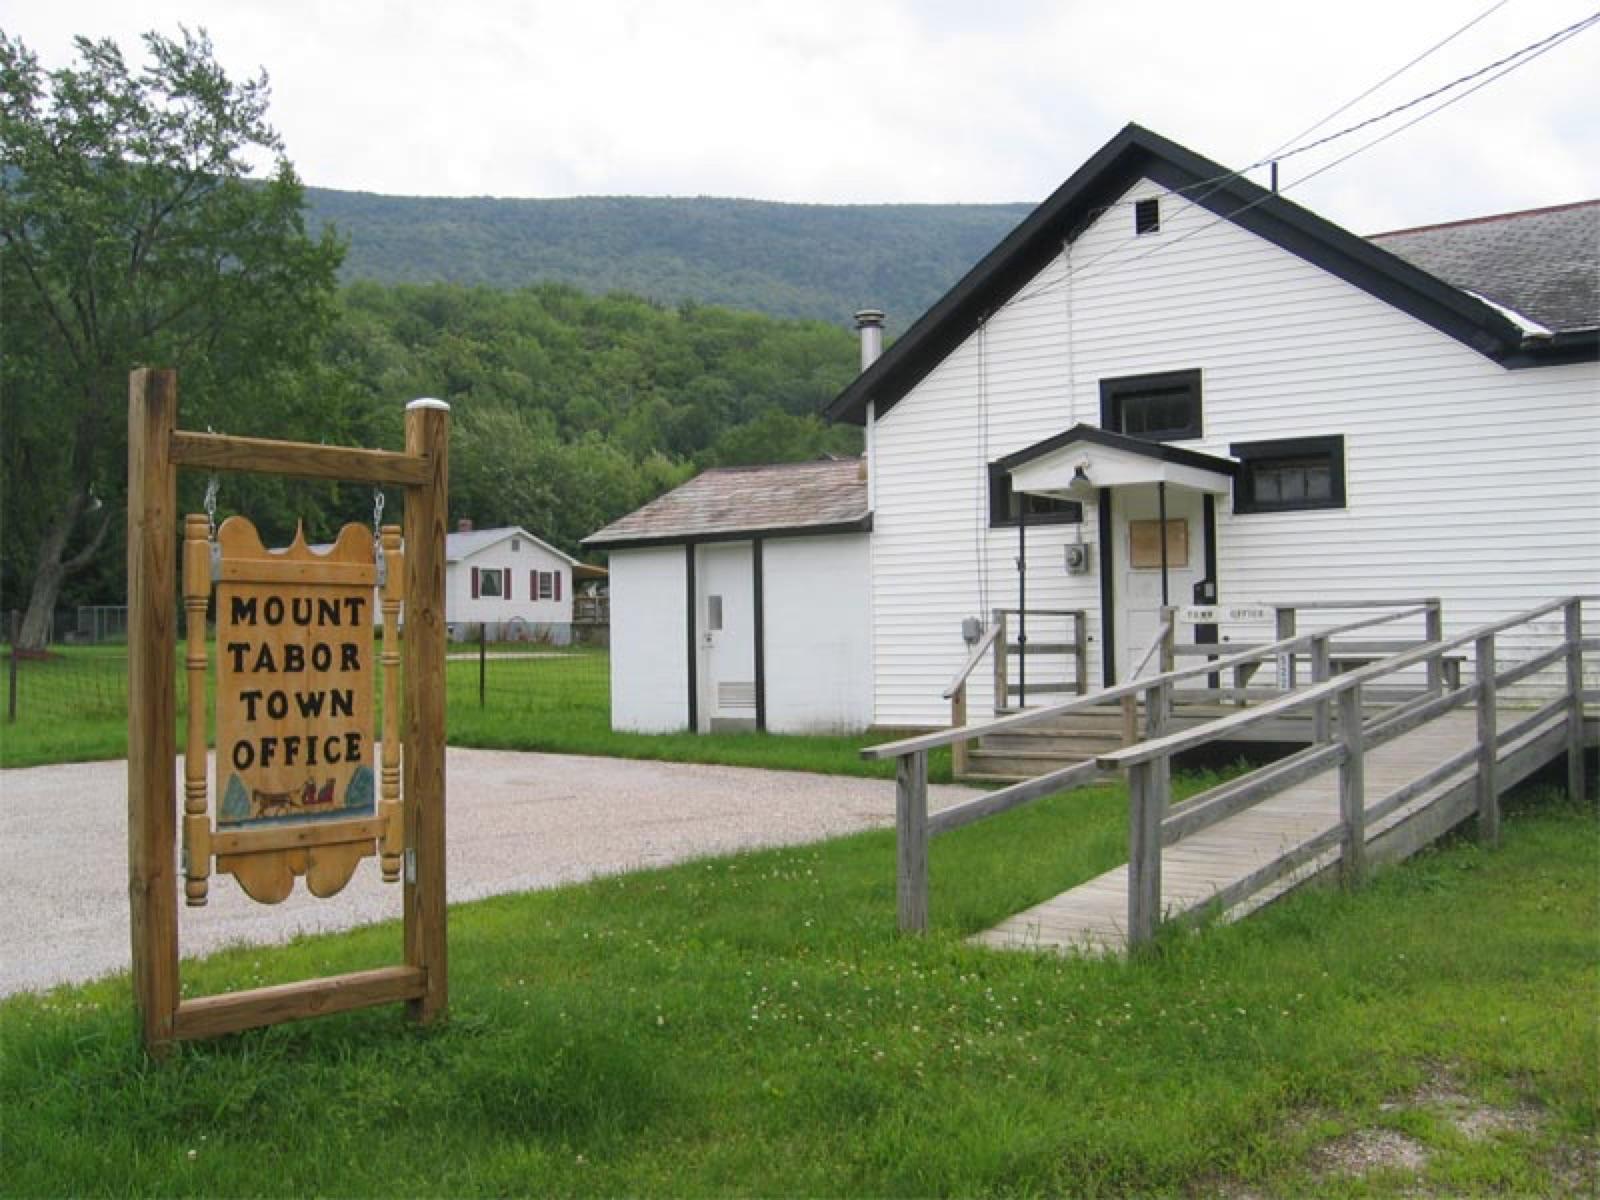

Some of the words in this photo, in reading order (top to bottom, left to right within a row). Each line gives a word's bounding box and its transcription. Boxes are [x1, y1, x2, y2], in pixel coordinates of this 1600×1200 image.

[231, 596, 366, 627] MOUNT
[227, 642, 361, 674] TABOR
[239, 689, 354, 721] TOWN
[232, 732, 362, 771] OFFICE
